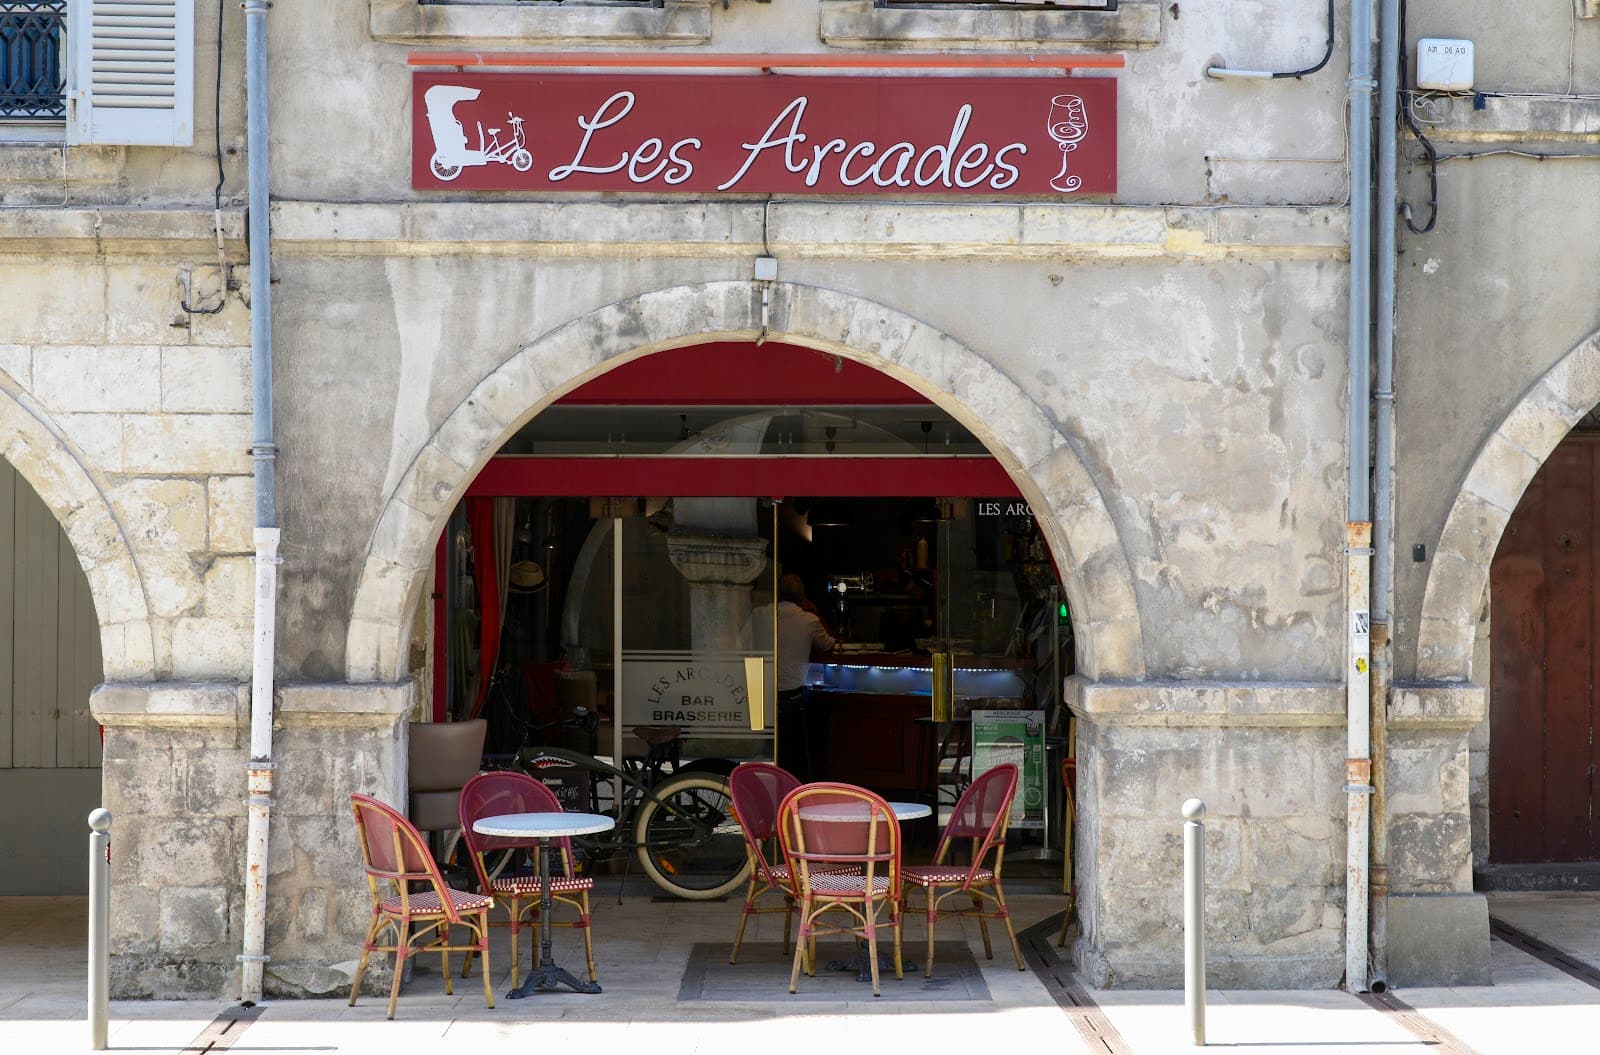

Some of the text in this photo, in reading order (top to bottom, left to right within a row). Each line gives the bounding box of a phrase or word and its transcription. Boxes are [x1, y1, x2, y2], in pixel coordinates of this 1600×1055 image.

[548, 90, 1028, 191] Les Arcades
[978, 502, 1001, 516] LES
[647, 675, 671, 705] LES
[681, 695, 714, 706] BAR
[652, 710, 743, 721] BRASSERIE
